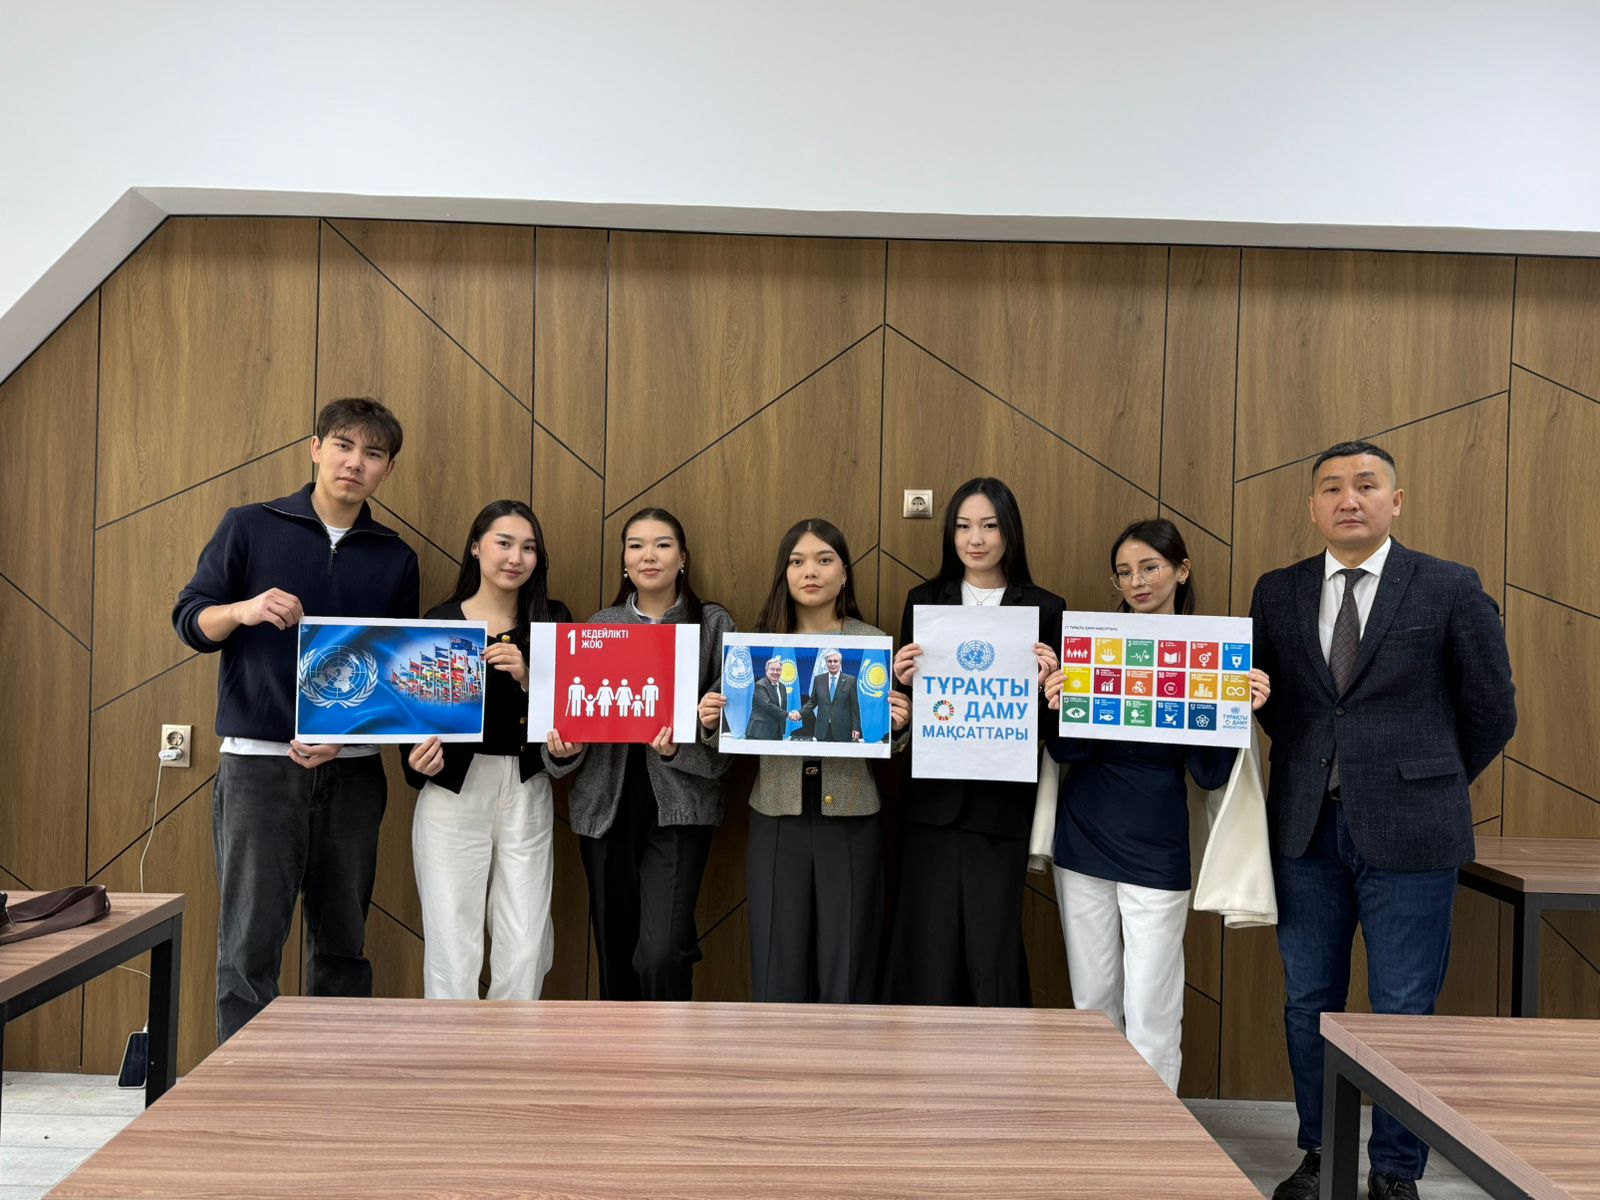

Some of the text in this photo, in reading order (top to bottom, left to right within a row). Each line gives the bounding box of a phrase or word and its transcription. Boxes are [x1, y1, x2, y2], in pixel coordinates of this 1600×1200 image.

[567, 628, 629, 656] 1 КЕДЕЙЛІКТІ
[581, 639, 604, 649] ЖОЮ
[922, 676, 1029, 700] ТҰРАҚТЫ
[964, 701, 1029, 722] ДАМУ
[922, 725, 1028, 741] МАҚСАТТАРЫ
